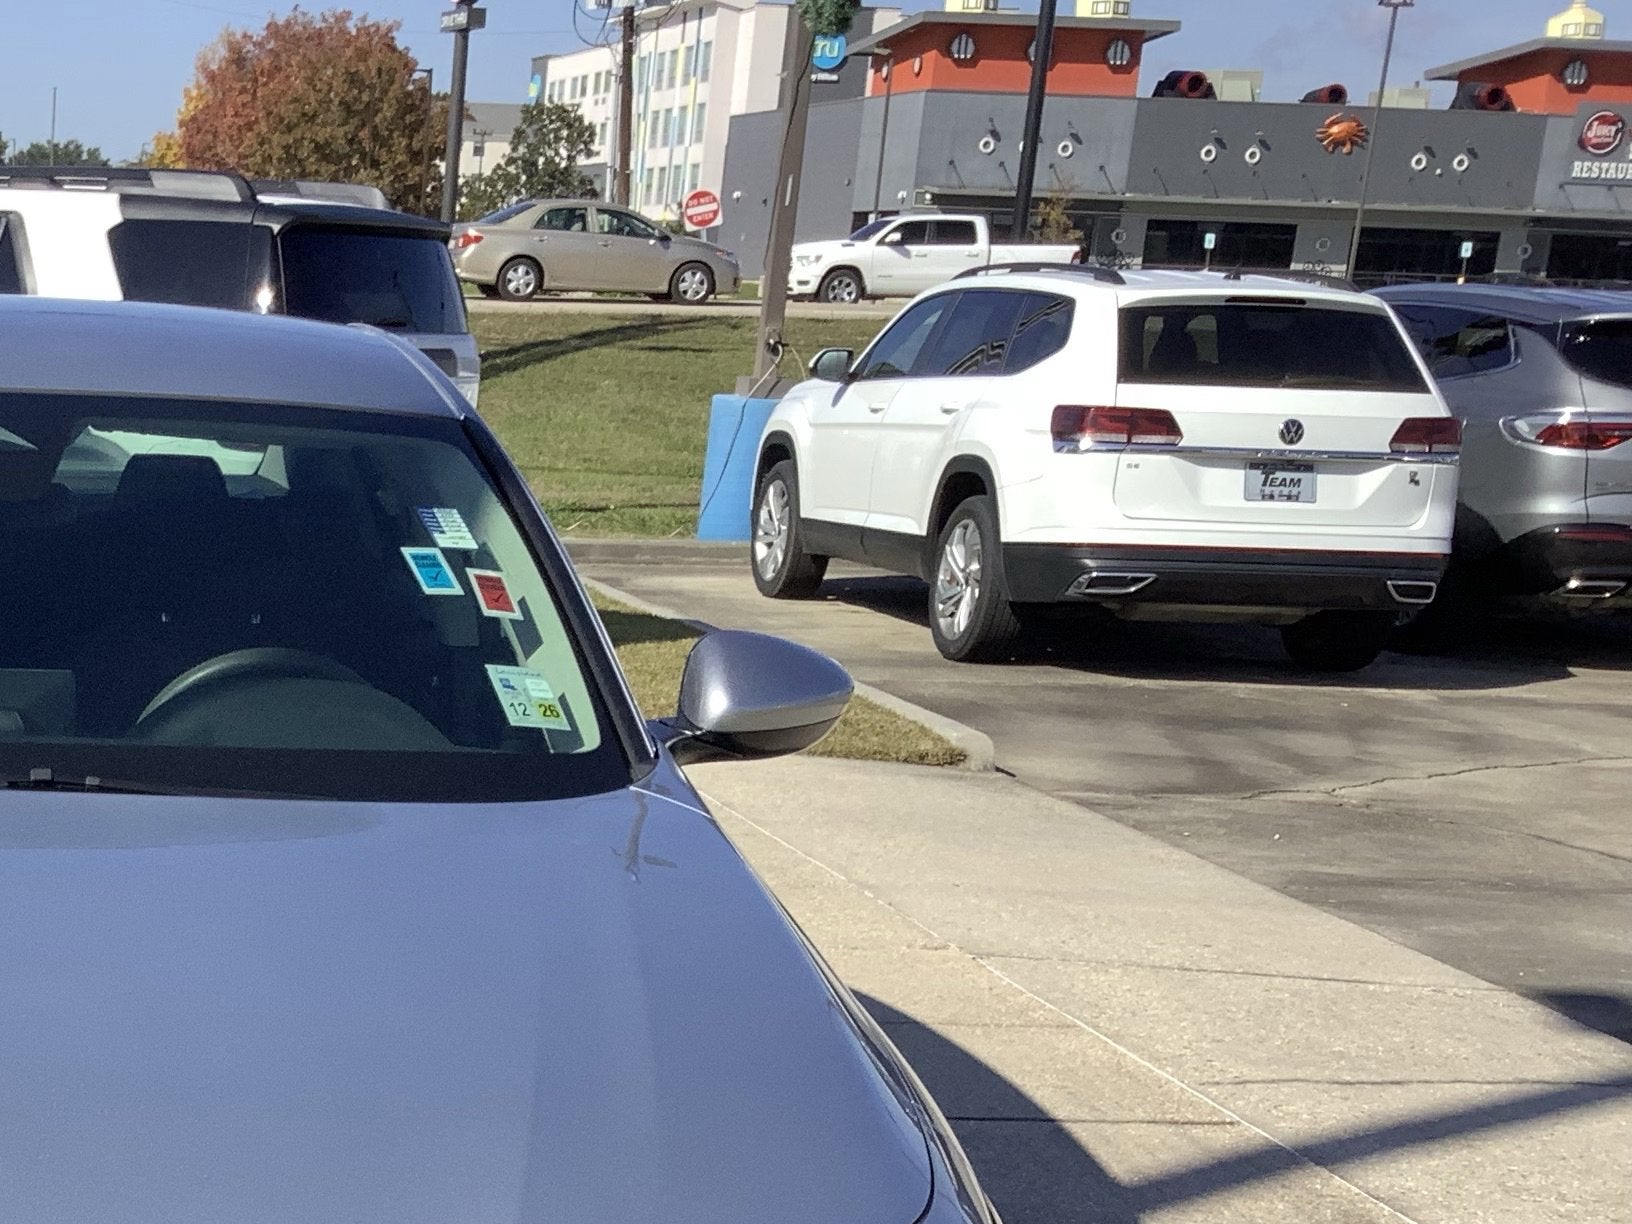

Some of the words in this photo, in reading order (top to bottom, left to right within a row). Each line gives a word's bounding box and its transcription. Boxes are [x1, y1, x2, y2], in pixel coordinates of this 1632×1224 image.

[688, 198, 699, 207] DO
[699, 194, 714, 204] NOT
[692, 212, 715, 223] ENTER
[1261, 468, 1302, 489] TEAM
[509, 702, 531, 717] 12
[538, 703, 561, 718] 26
